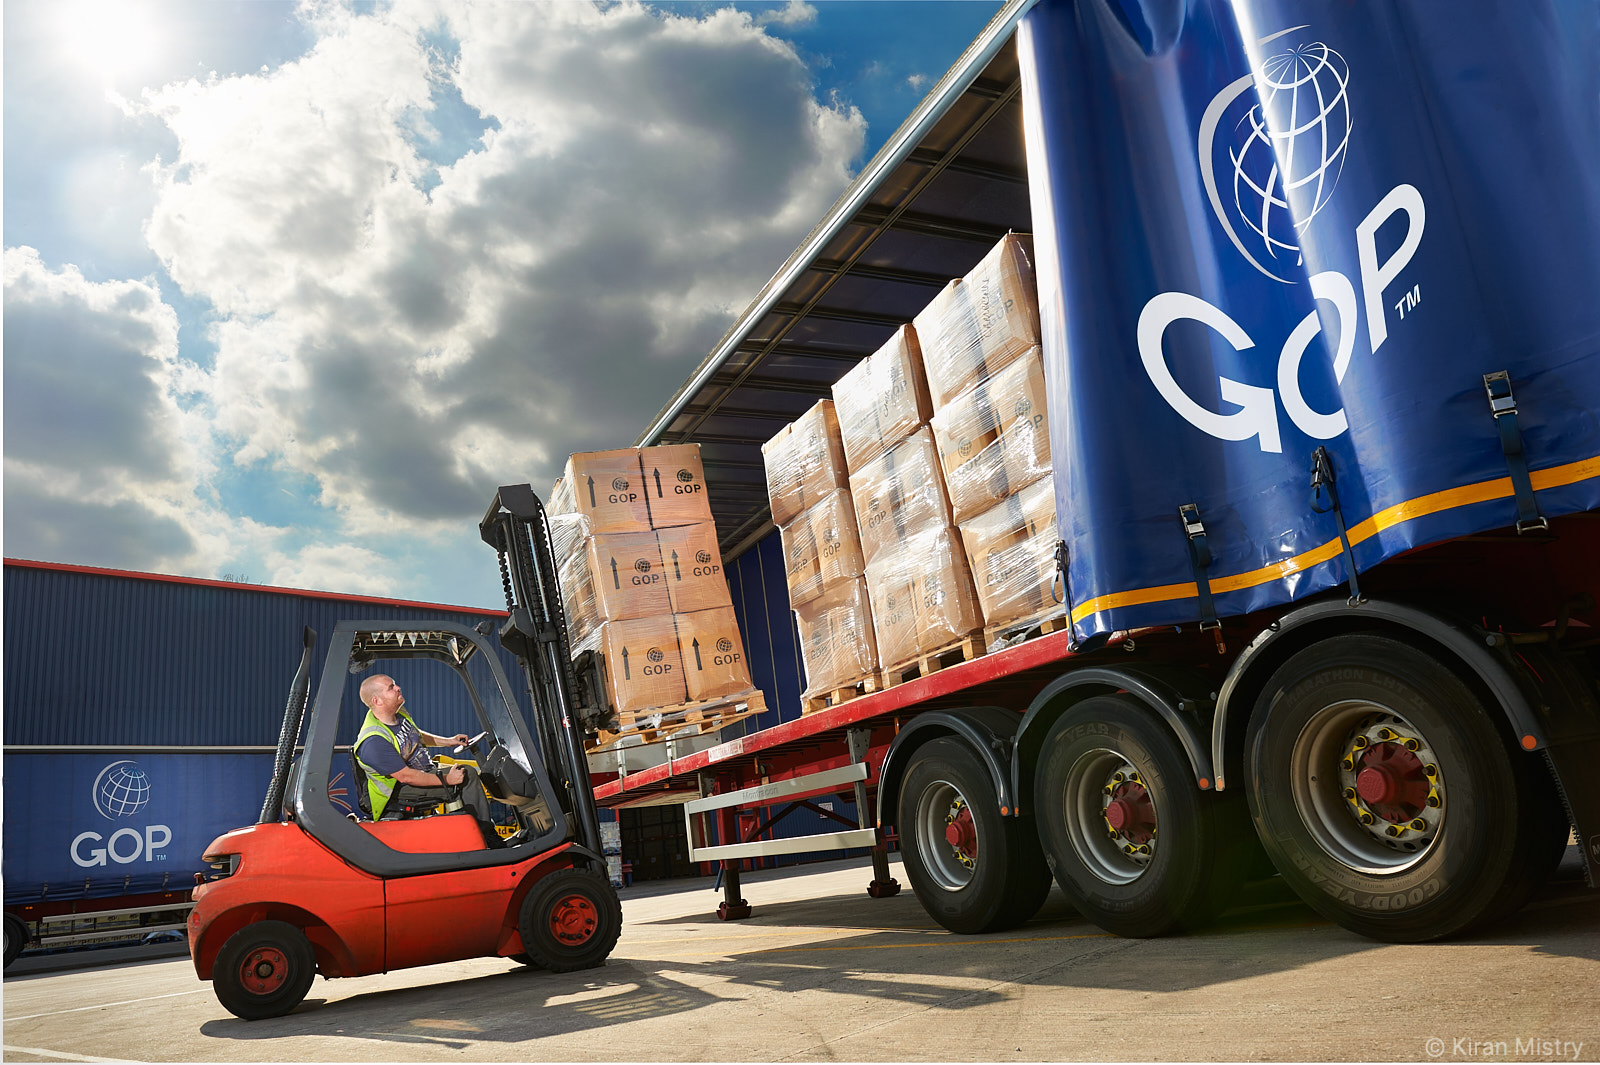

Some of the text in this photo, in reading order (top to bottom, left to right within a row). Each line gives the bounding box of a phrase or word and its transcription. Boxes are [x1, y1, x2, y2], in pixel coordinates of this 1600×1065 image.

[1137, 183, 1426, 454] GOP TM
[674, 483, 701, 495] GOP
[608, 493, 637, 504] GOP
[868, 510, 886, 528] GOP
[823, 542, 841, 558] GOP
[693, 565, 720, 577] GOP
[632, 574, 659, 586] GOP
[714, 653, 741, 666] GOP
[643, 664, 672, 676] GOP
[70, 824, 172, 868] GOP
[1289, 850, 1440, 911] GOODYEAR
